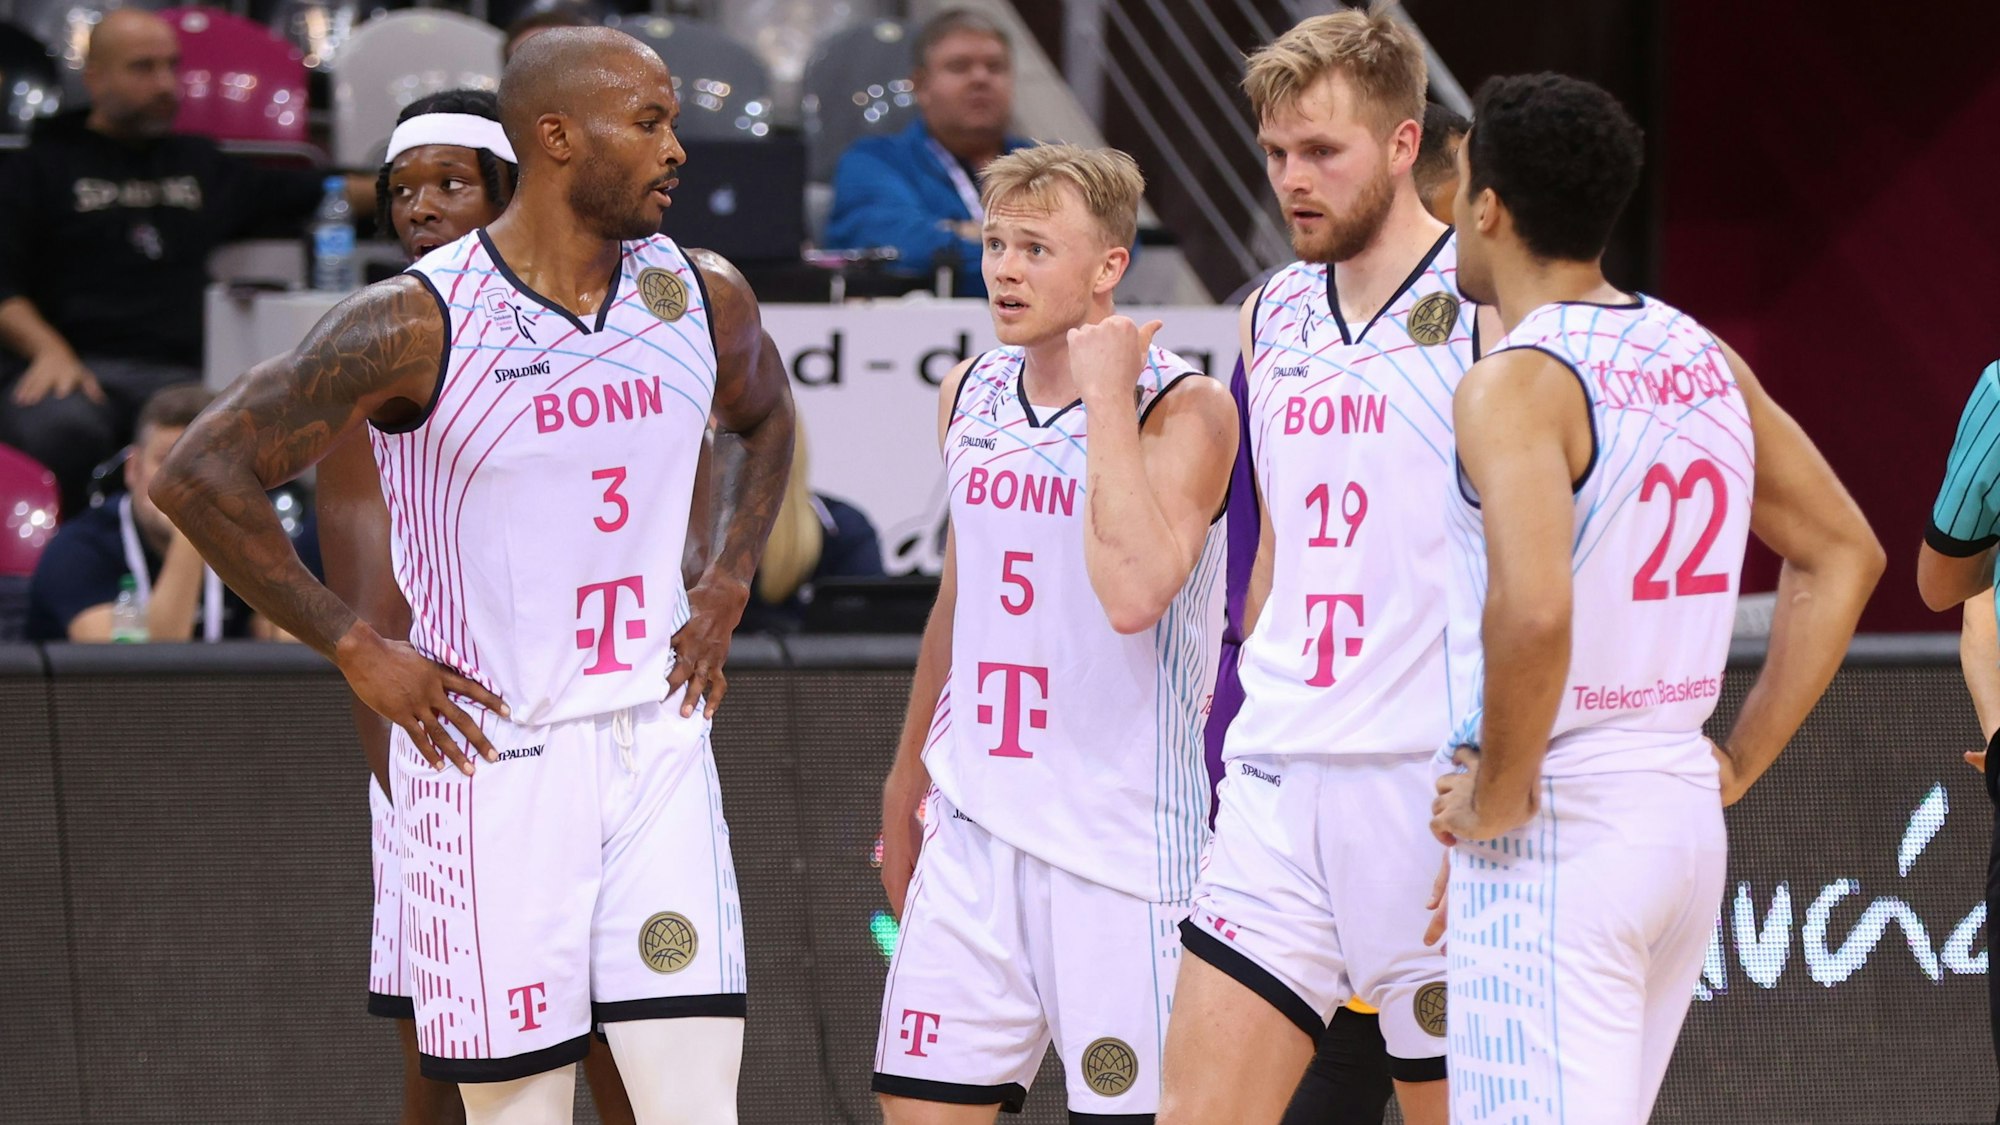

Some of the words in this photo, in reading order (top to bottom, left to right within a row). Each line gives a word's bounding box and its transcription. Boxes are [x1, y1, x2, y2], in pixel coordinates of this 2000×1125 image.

[494, 361, 551, 384] SPALDING
[1271, 365, 1309, 380] SPALDING
[533, 376, 663, 434] BONN
[1283, 394, 1387, 435] BONN
[958, 435, 998, 450] SPALDING
[592, 466, 629, 532] 3
[966, 467, 1077, 516] BONN
[1305, 481, 1369, 548] 19
[1632, 458, 1730, 602] 22
[1000, 551, 1034, 616] 5
[1573, 684, 1657, 711] Telekom
[1657, 675, 1717, 704] Baskets
[1241, 763, 1281, 788] SPALDING
